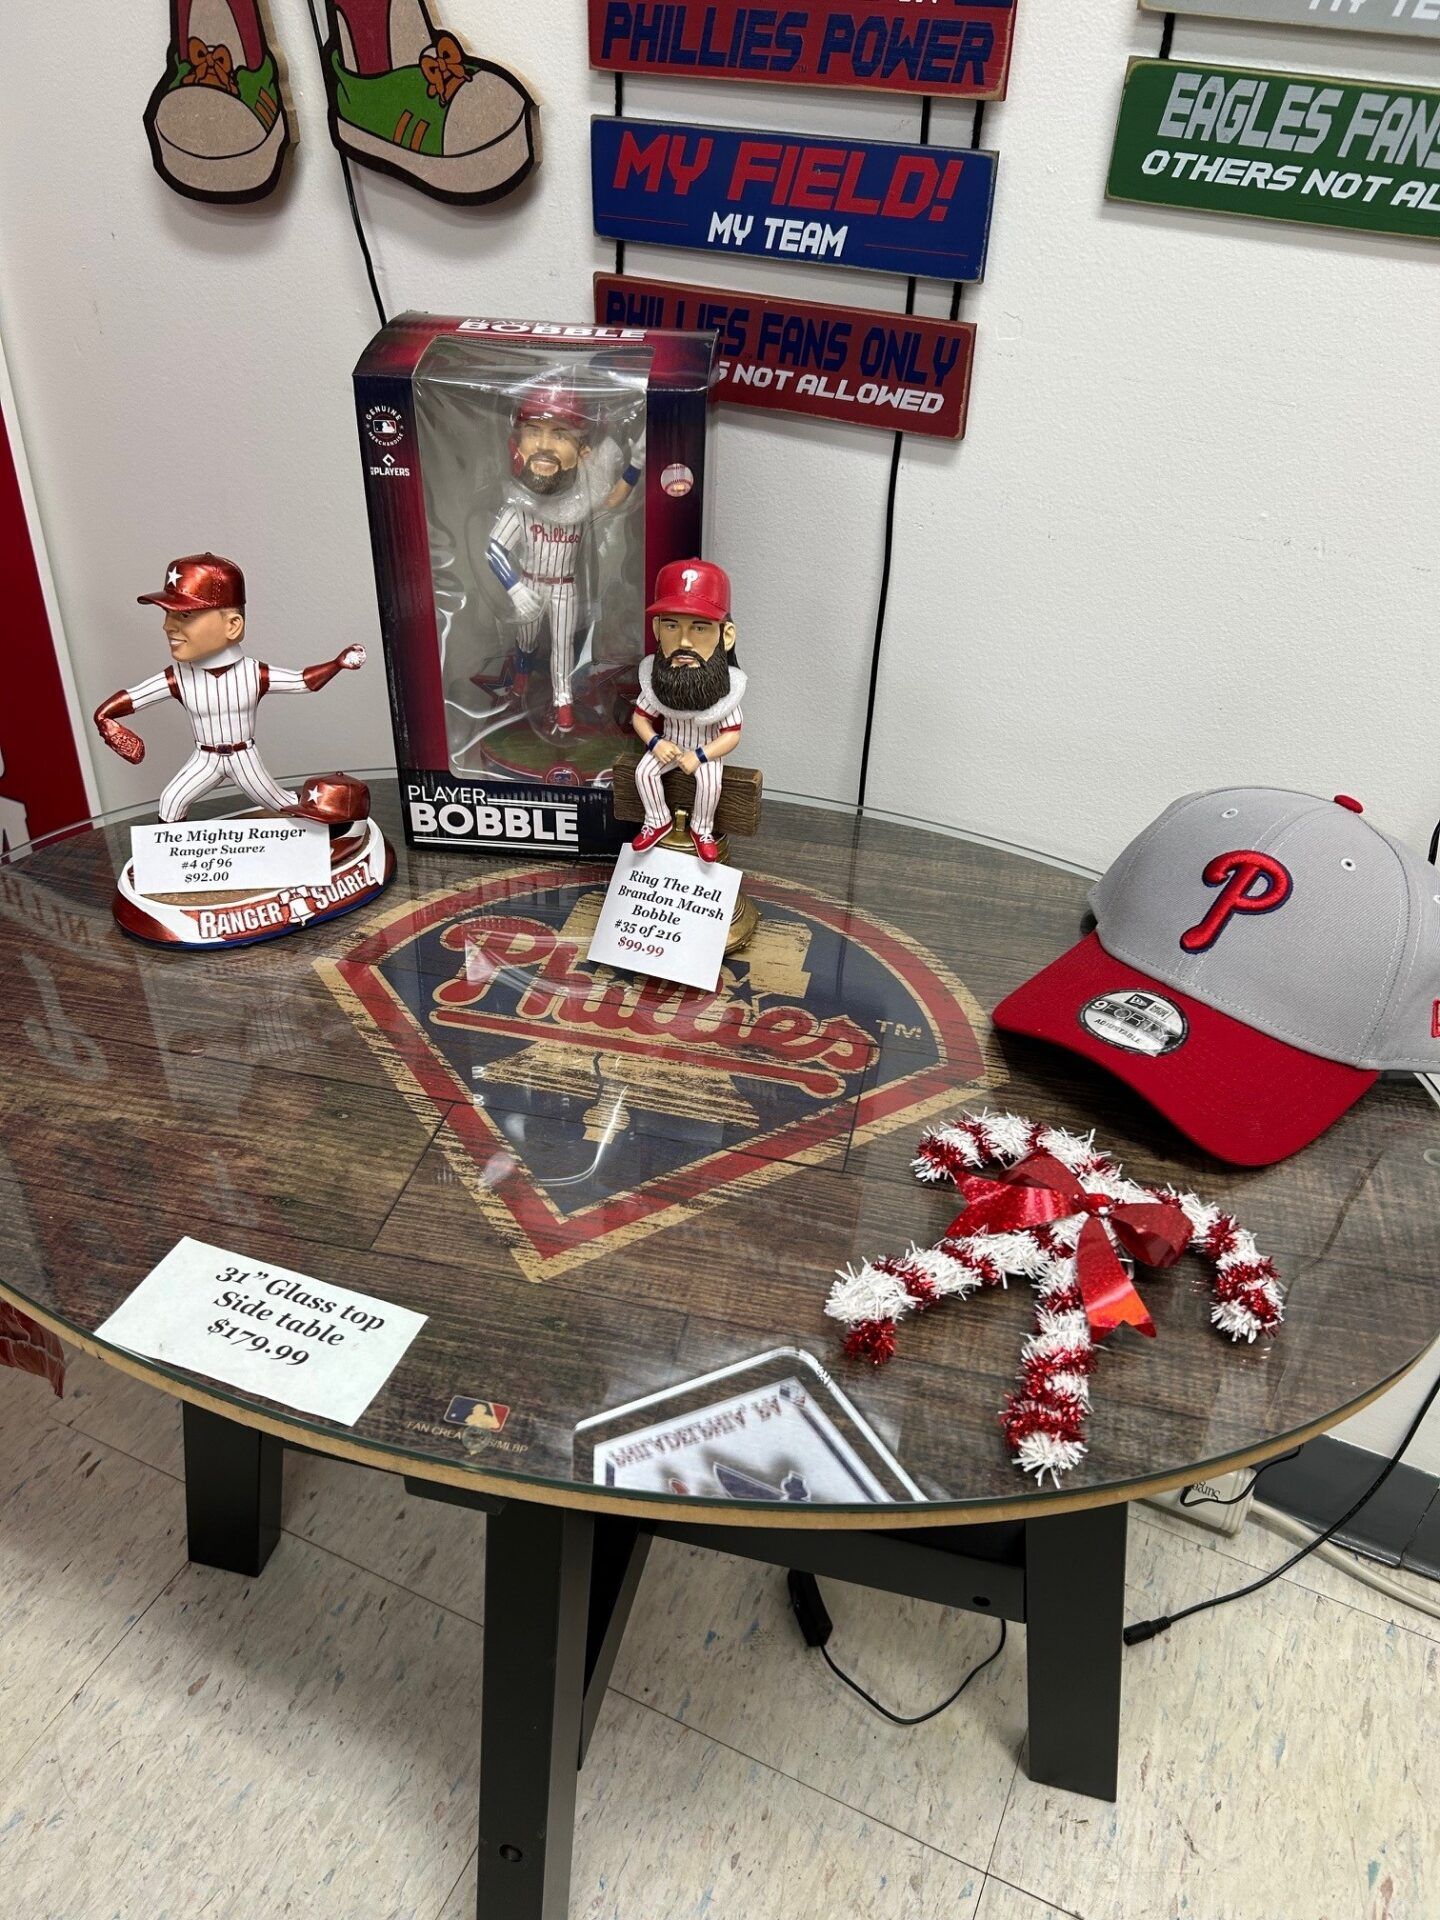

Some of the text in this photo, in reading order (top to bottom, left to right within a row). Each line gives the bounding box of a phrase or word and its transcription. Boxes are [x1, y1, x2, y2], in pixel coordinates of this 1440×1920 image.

[601, 2, 995, 86] PHILLIES POWER
[1157, 72, 1345, 154] EAGLES
[613, 130, 964, 222] MY FIELD!
[1141, 149, 1304, 191] OTHERS
[1301, 168, 1394, 203] NOT
[708, 212, 849, 258] MY TEAM
[458, 321, 648, 338] BOBBLE
[757, 311, 852, 373] FANS
[860, 322, 962, 387] ONLY
[732, 364, 795, 391] NOT
[796, 373, 945, 414] ALLOWED
[365, 405, 402, 421] GENUINE
[368, 431, 404, 446] MERCHANDISE
[530, 523, 581, 543] Phillies
[408, 785, 487, 804] PLAYER
[154, 826, 307, 843] The Mighty Ranger
[410, 802, 579, 842] BOBBLE
[169, 844, 266, 858] Ranger Suarez
[181, 857, 233, 870] #4 of 96
[184, 871, 229, 884] $92.00
[628, 870, 722, 903] Ring The Bell
[617, 885, 725, 921] Brandon Marsh
[631, 904, 681, 926] Bobble
[1180, 850, 1293, 954] P
[200, 902, 284, 938] RANGER
[614, 918, 682, 943] #35 of 216
[617, 935, 665, 958] $99.99
[876, 1019, 923, 1041] TM
[213, 1291, 345, 1347] Side table
[264, 1278, 338, 1314] Glass
[340, 1305, 385, 1332] top
[207, 1318, 310, 1367] $179.99
[406, 1421, 430, 1433] FAN
